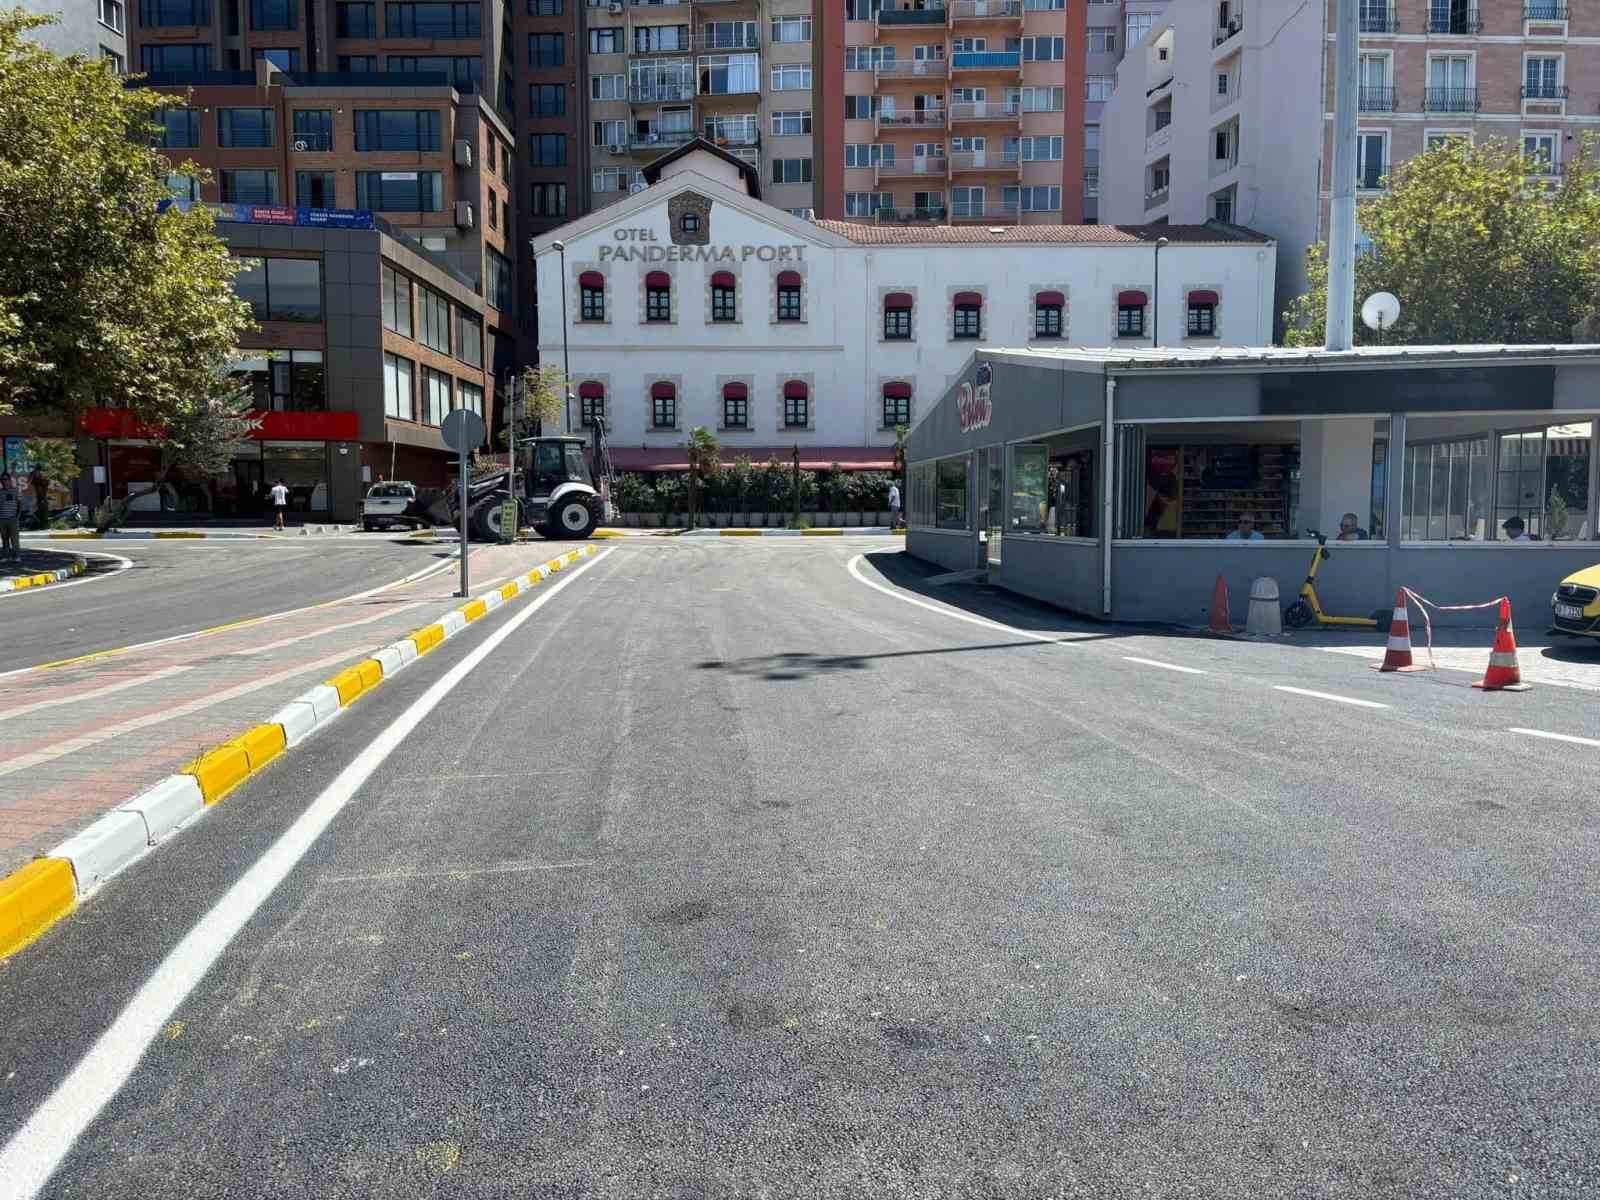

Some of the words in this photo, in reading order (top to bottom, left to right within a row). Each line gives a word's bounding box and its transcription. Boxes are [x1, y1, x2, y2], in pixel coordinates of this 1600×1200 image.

[614, 228, 658, 241] OTEL
[599, 245, 736, 262] PANDERMA
[741, 245, 807, 262] PORT
